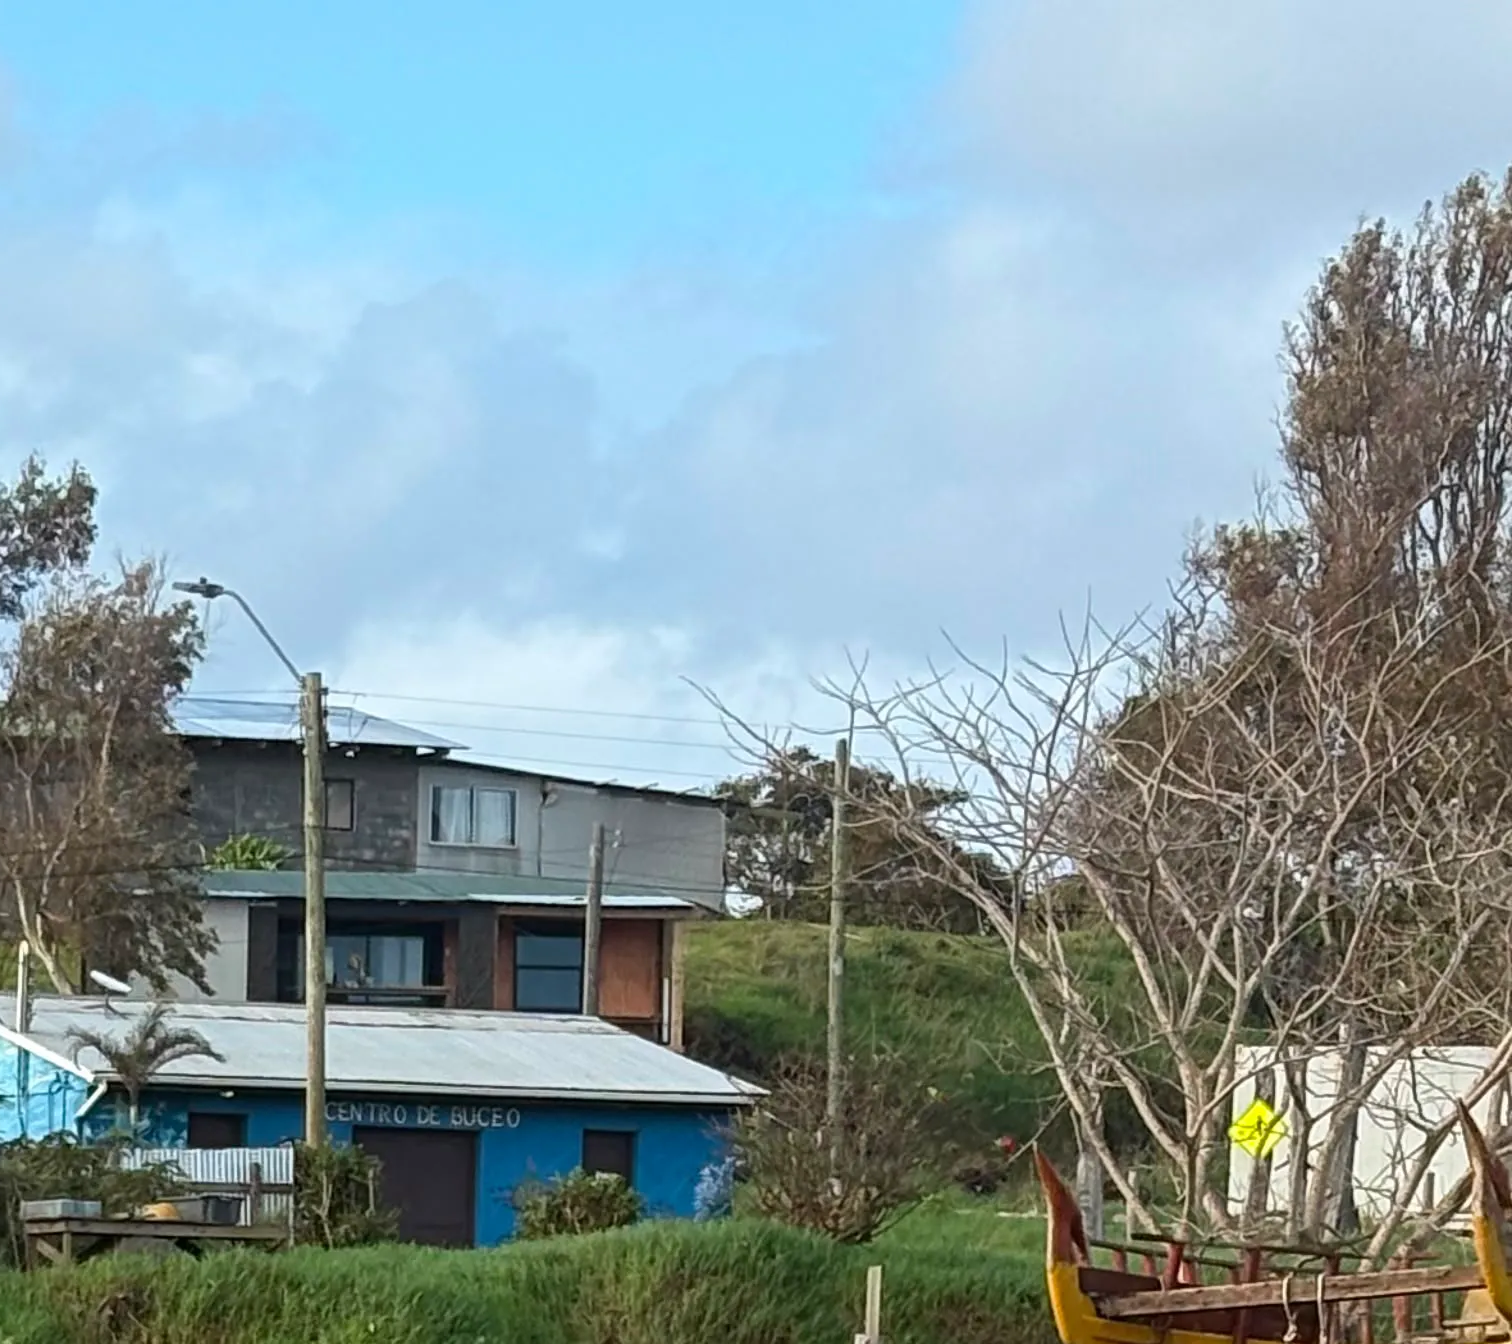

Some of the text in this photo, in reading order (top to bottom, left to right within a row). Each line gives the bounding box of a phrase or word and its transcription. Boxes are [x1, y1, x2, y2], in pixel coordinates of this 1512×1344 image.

[324, 1102, 521, 1129] CENTRO DE BUCEO
